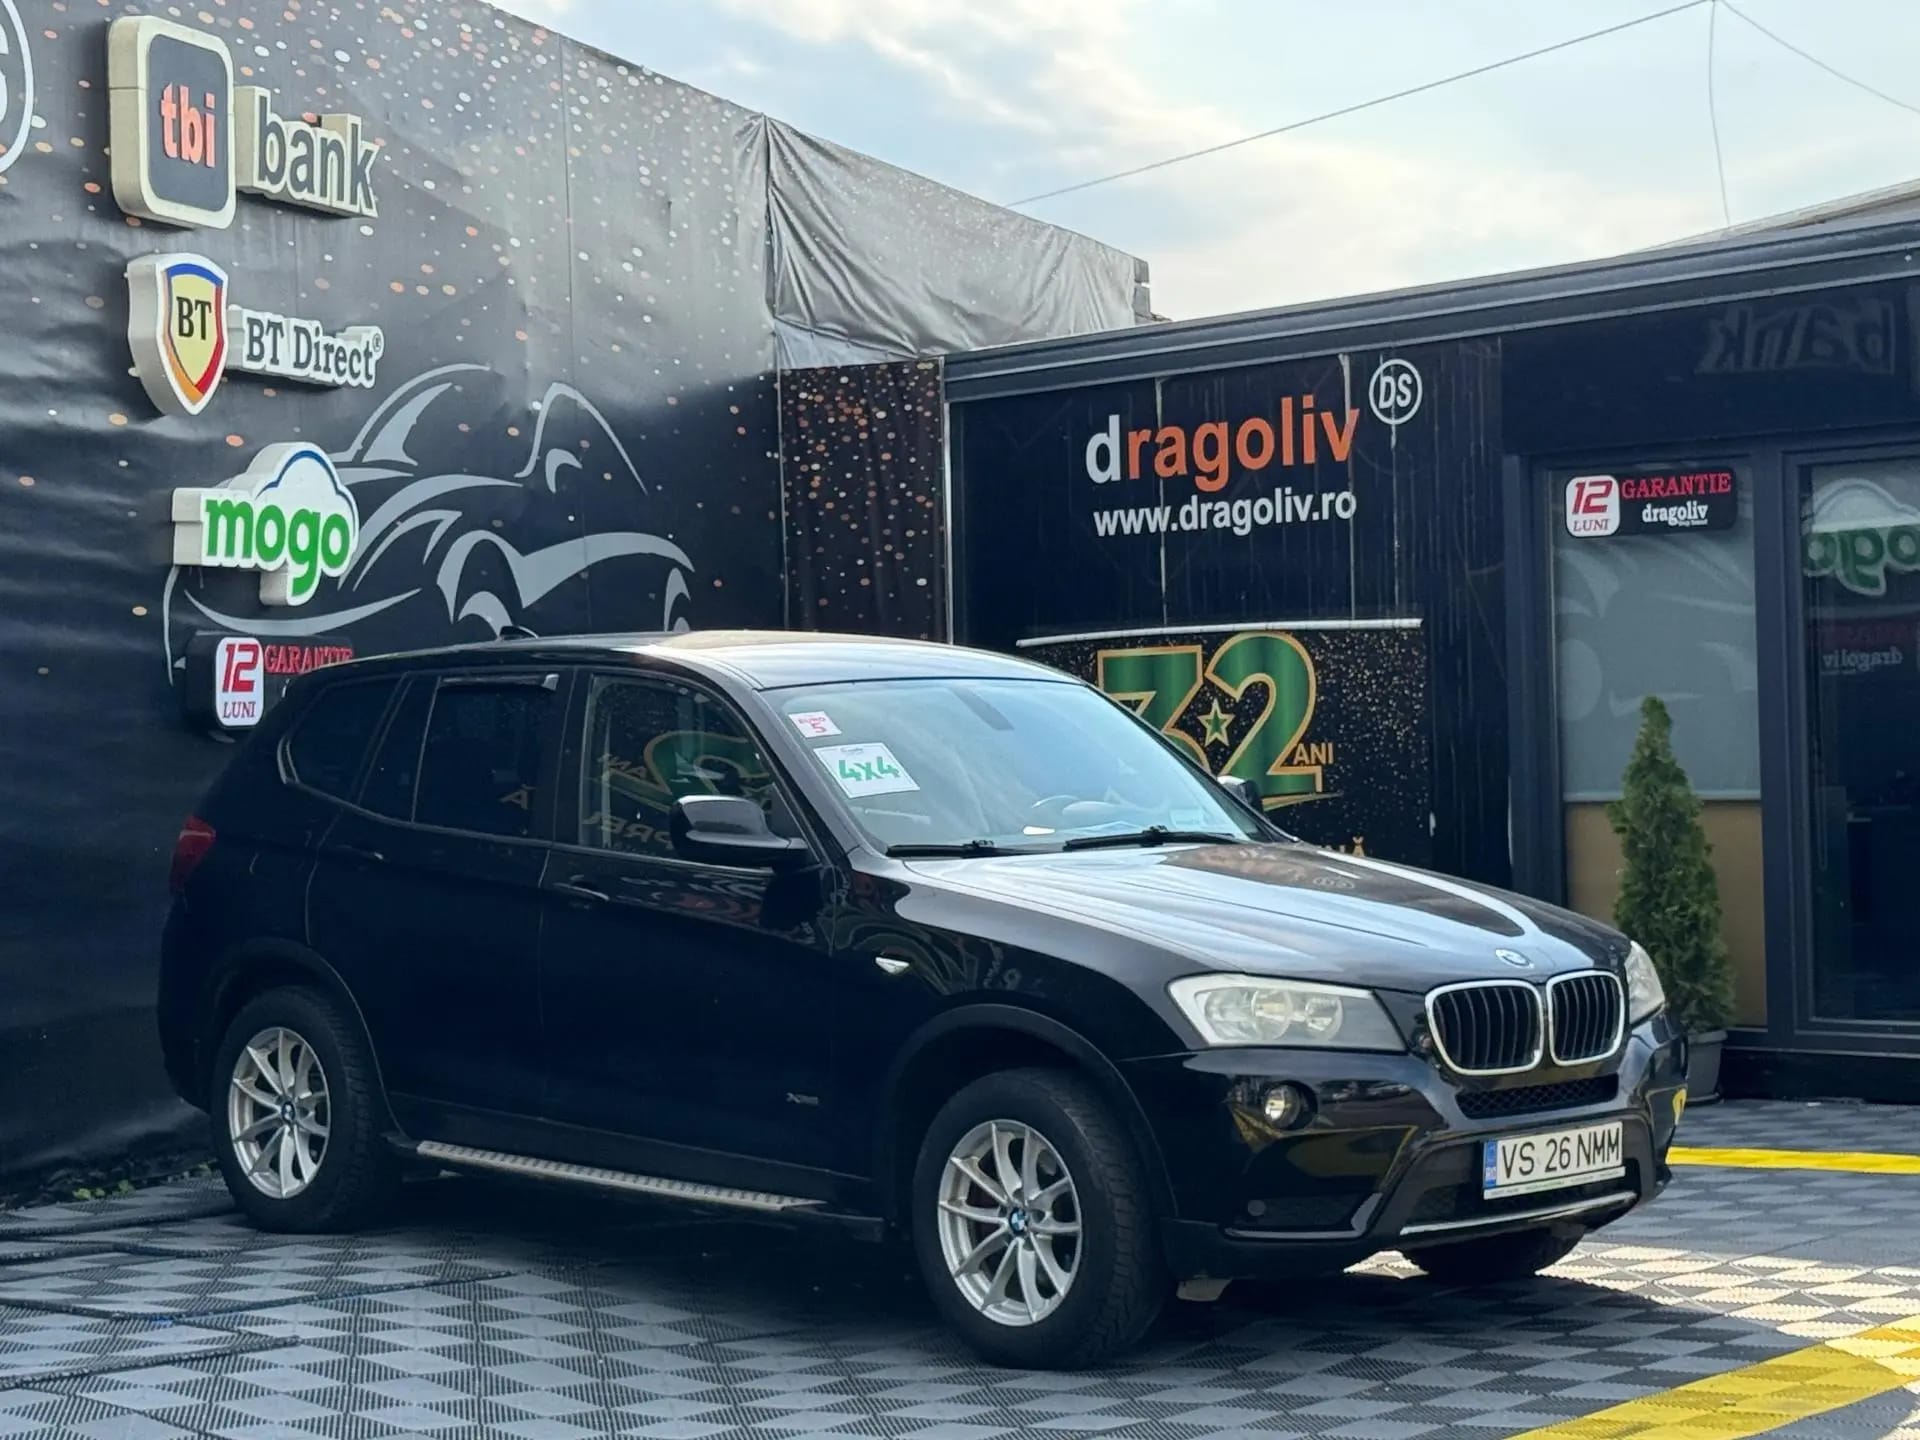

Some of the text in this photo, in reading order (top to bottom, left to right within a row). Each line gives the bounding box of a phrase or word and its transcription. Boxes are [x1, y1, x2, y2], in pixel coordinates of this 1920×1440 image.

[161, 82, 376, 212] tbi bank
[176, 296, 212, 341] BT
[246, 317, 284, 366] BT
[1378, 373, 1413, 410] DS
[1086, 394, 1359, 492] dragoliv
[1572, 481, 1613, 515] 12
[1621, 473, 1731, 499] GARANTIE
[1093, 486, 1357, 536] www.dragoliv.ro
[1573, 518, 1611, 532] LUNI
[1642, 500, 1708, 526] dragoliv
[205, 498, 350, 597] mogo
[222, 643, 259, 693] 12
[223, 701, 256, 719] LUNI
[1293, 741, 1334, 765] ANI
[1502, 1127, 1620, 1180] VS 26 NMM
